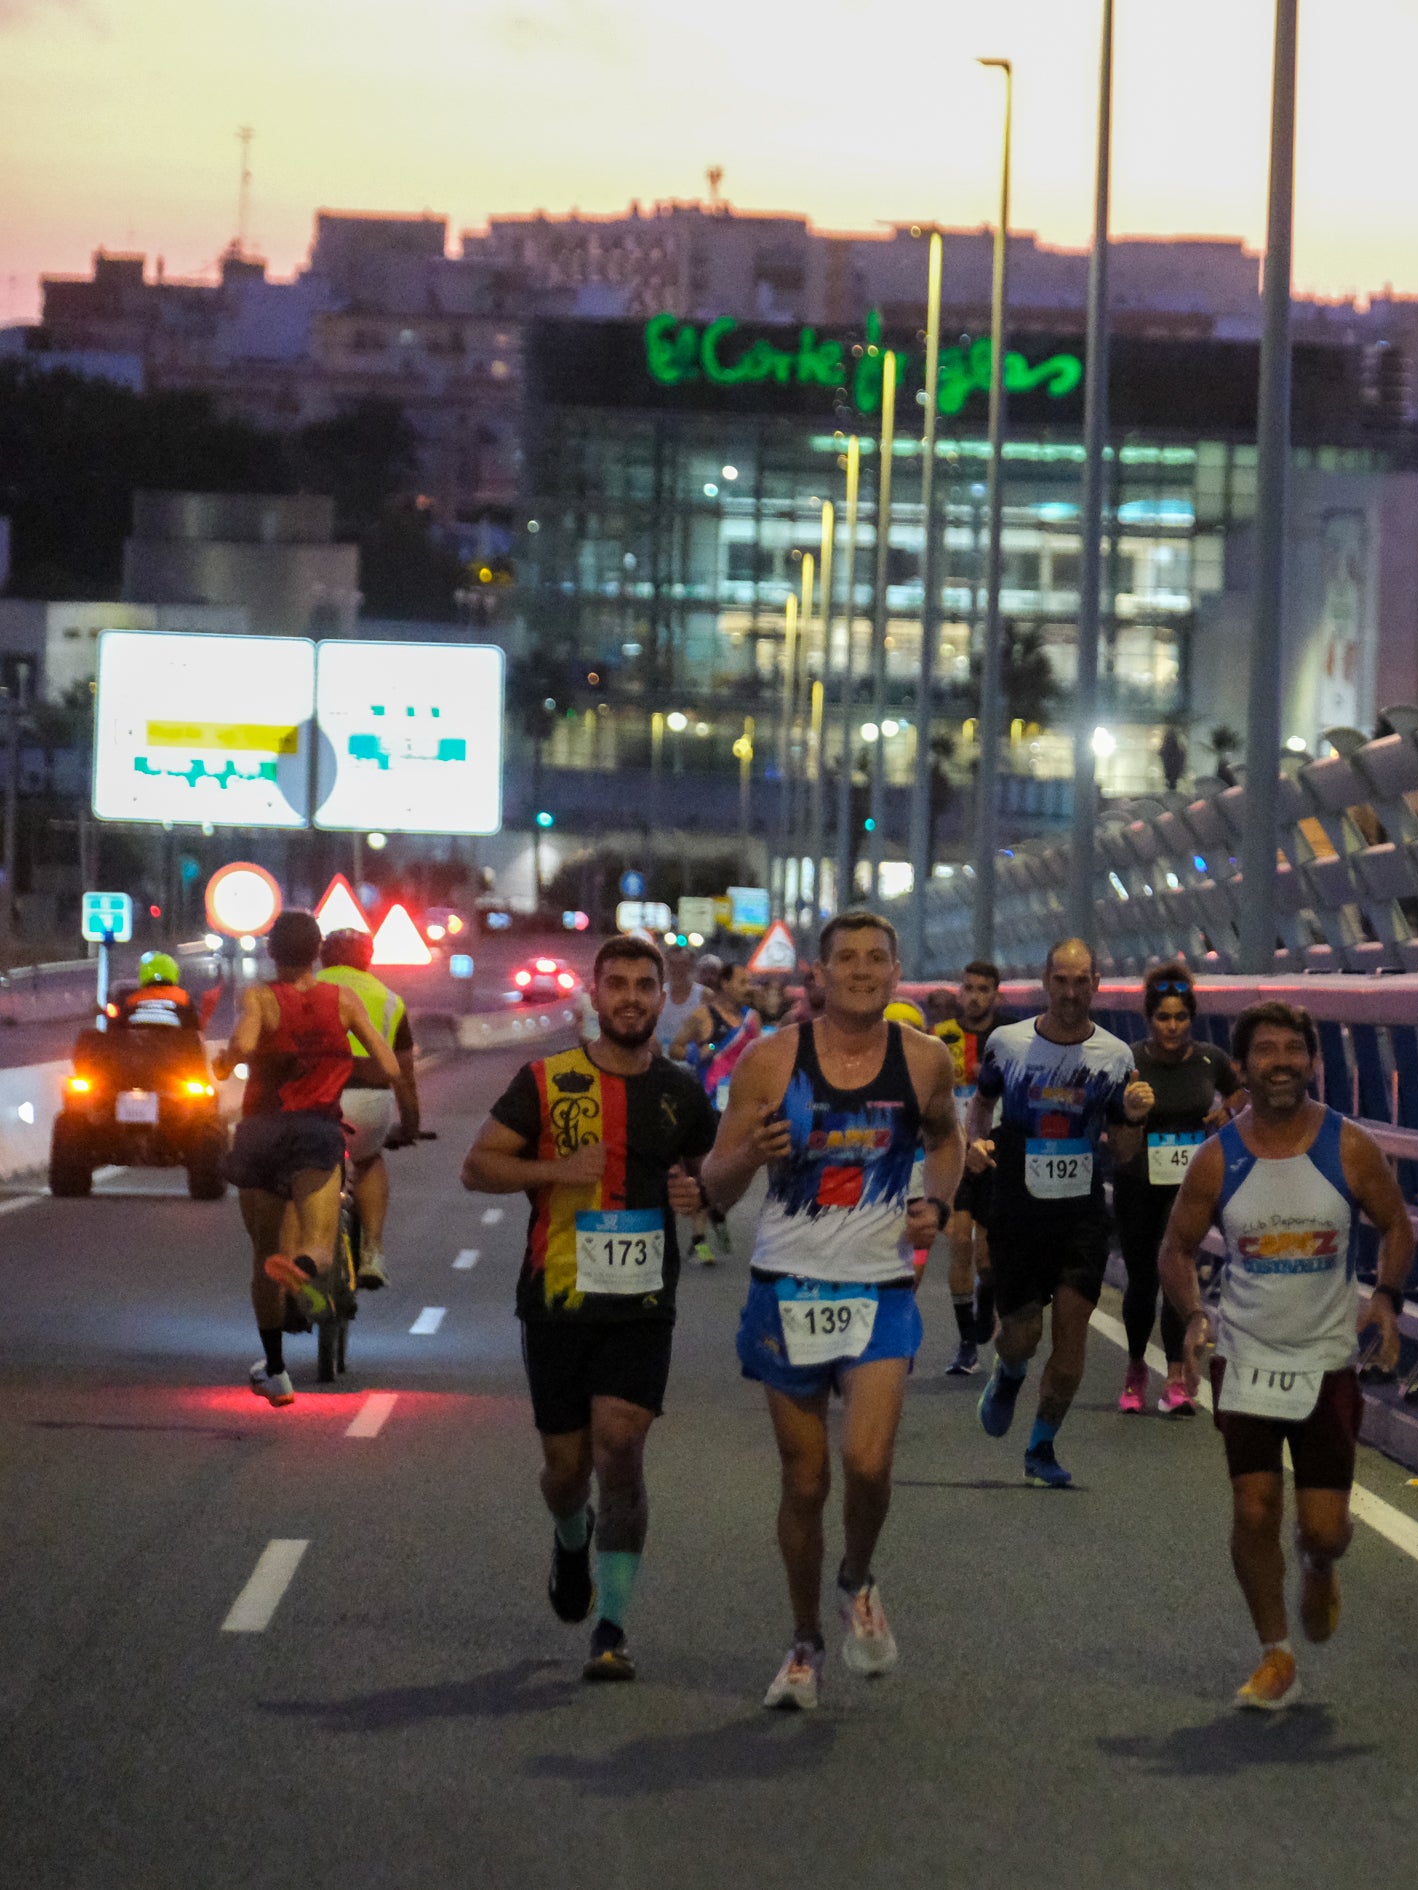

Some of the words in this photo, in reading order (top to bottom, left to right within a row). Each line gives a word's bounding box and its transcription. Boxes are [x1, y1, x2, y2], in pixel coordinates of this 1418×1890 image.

[645, 313, 698, 385] El
[701, 316, 846, 386] Corte
[1046, 1159, 1079, 1180] 192
[1170, 1150, 1189, 1167] 45
[604, 1239, 647, 1266] 173
[804, 1306, 851, 1335] 139
